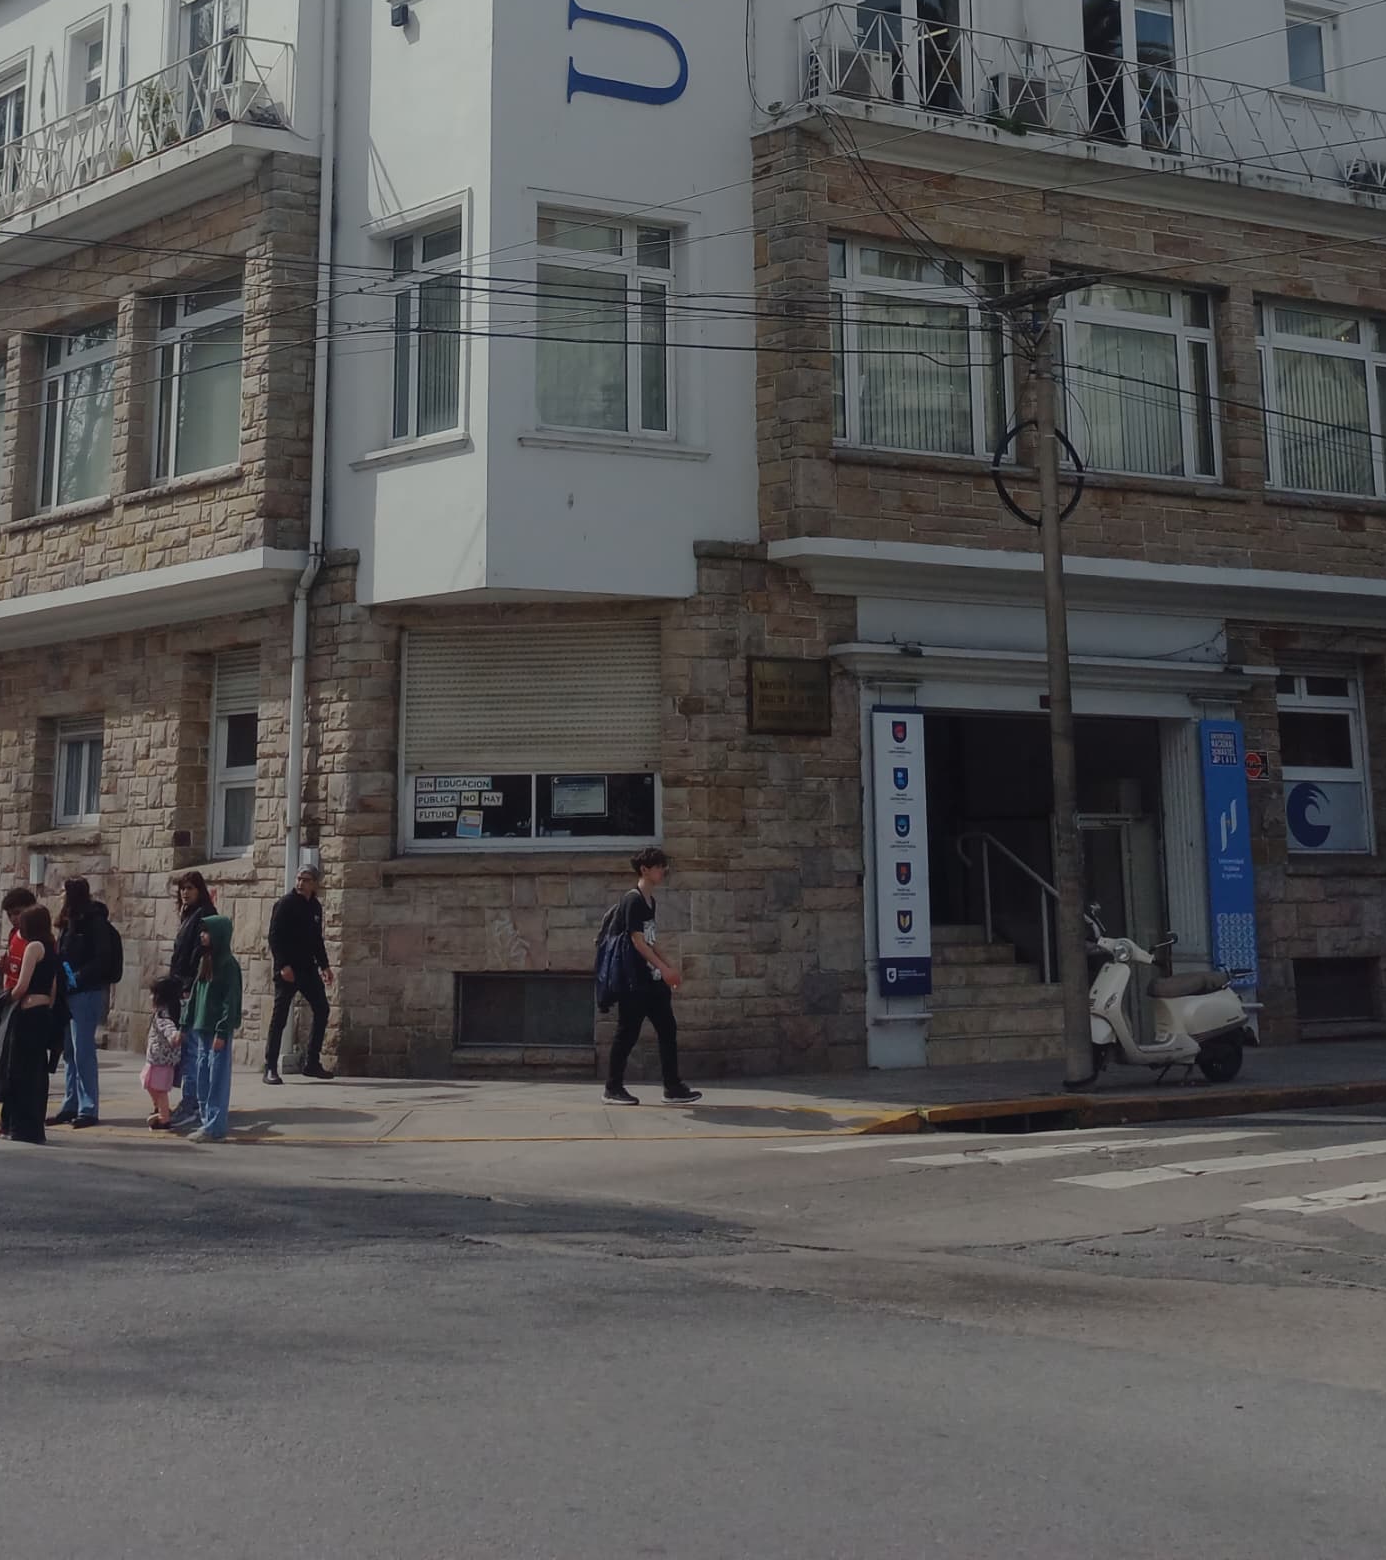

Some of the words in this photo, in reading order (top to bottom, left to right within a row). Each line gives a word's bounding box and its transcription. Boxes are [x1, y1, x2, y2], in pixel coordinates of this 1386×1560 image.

[418, 781, 433, 789] SIN
[463, 794, 476, 802] NO
[483, 795, 501, 803] HAY
[419, 810, 454, 819] FUTURO
